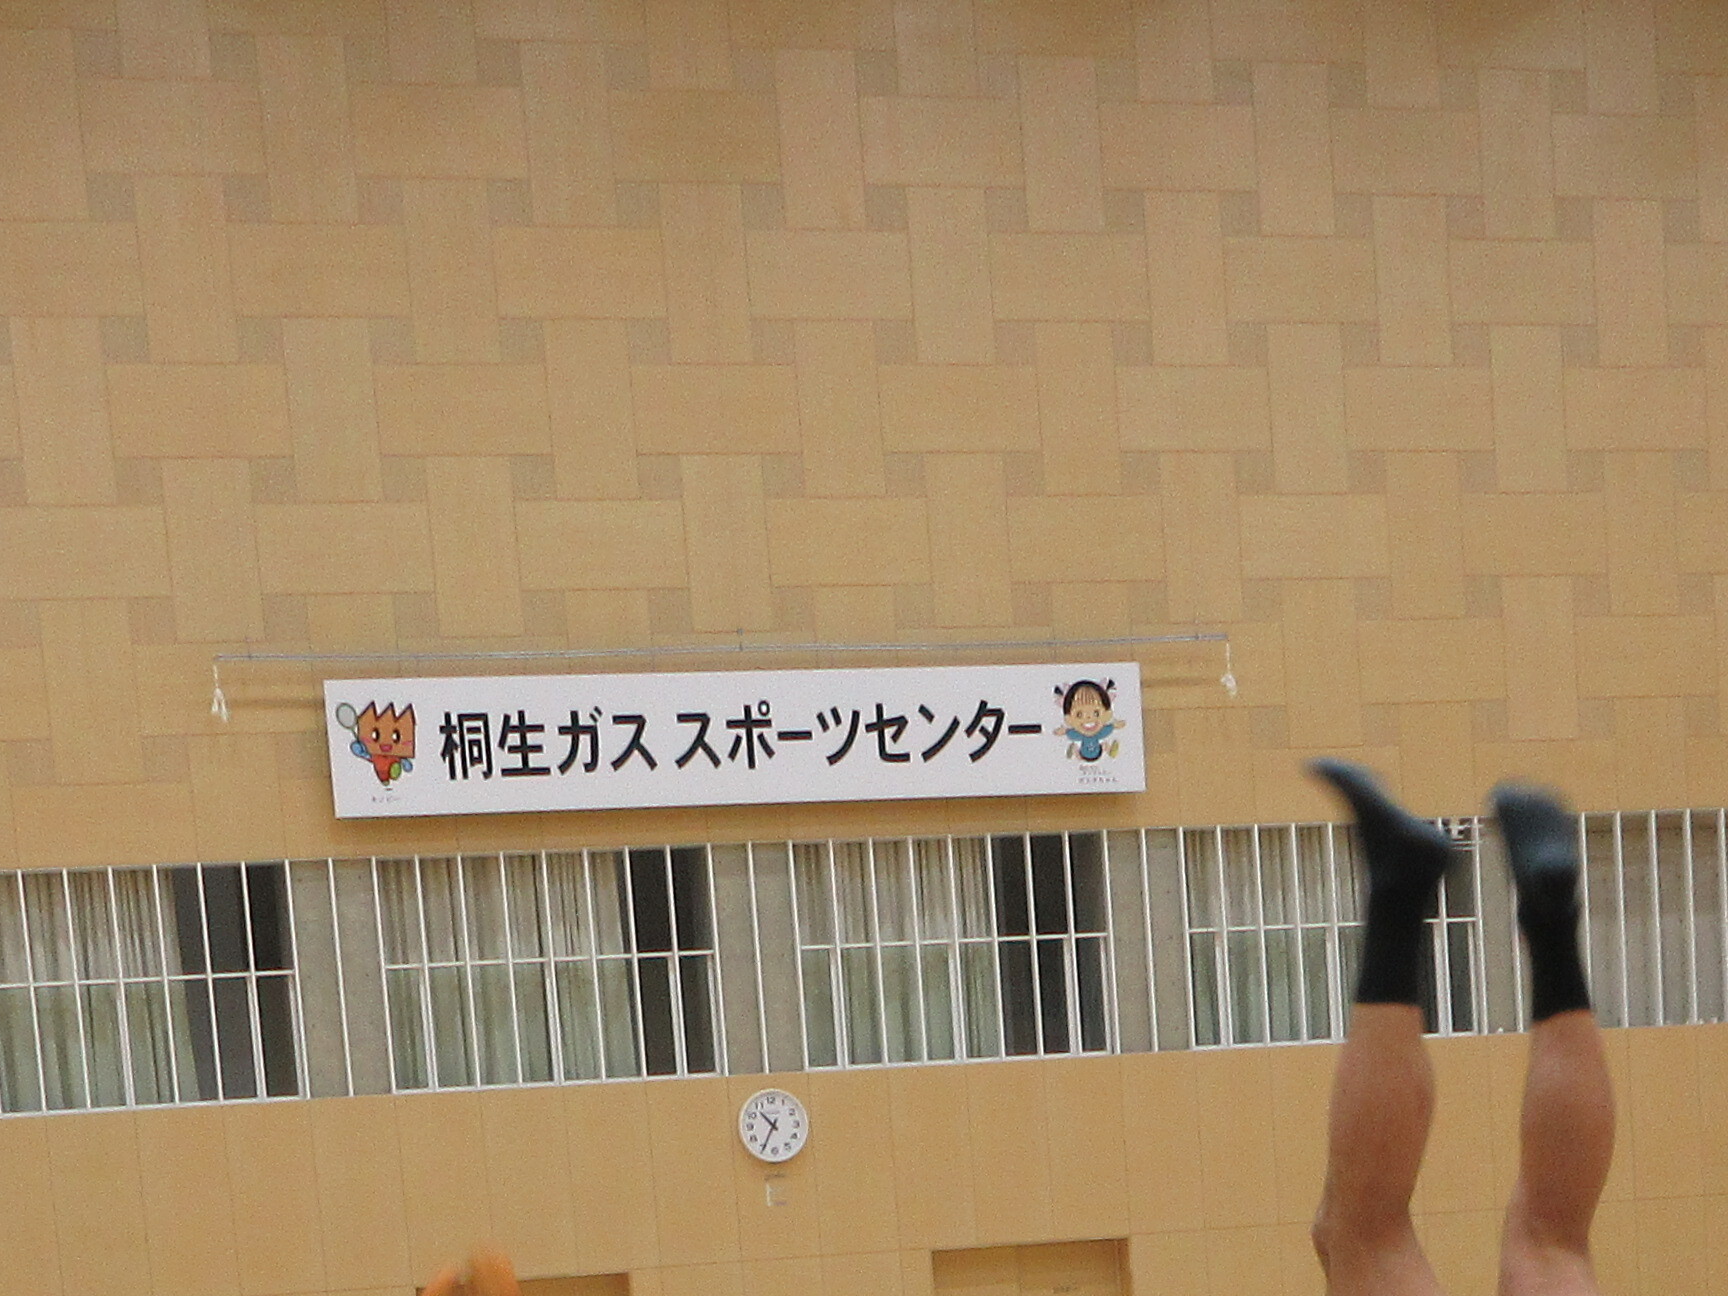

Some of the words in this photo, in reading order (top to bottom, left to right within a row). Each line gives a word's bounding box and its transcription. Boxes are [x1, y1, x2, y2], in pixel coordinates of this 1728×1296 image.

[439, 705, 659, 781] 桐生ガス
[674, 700, 1043, 770] スポーツセンター
